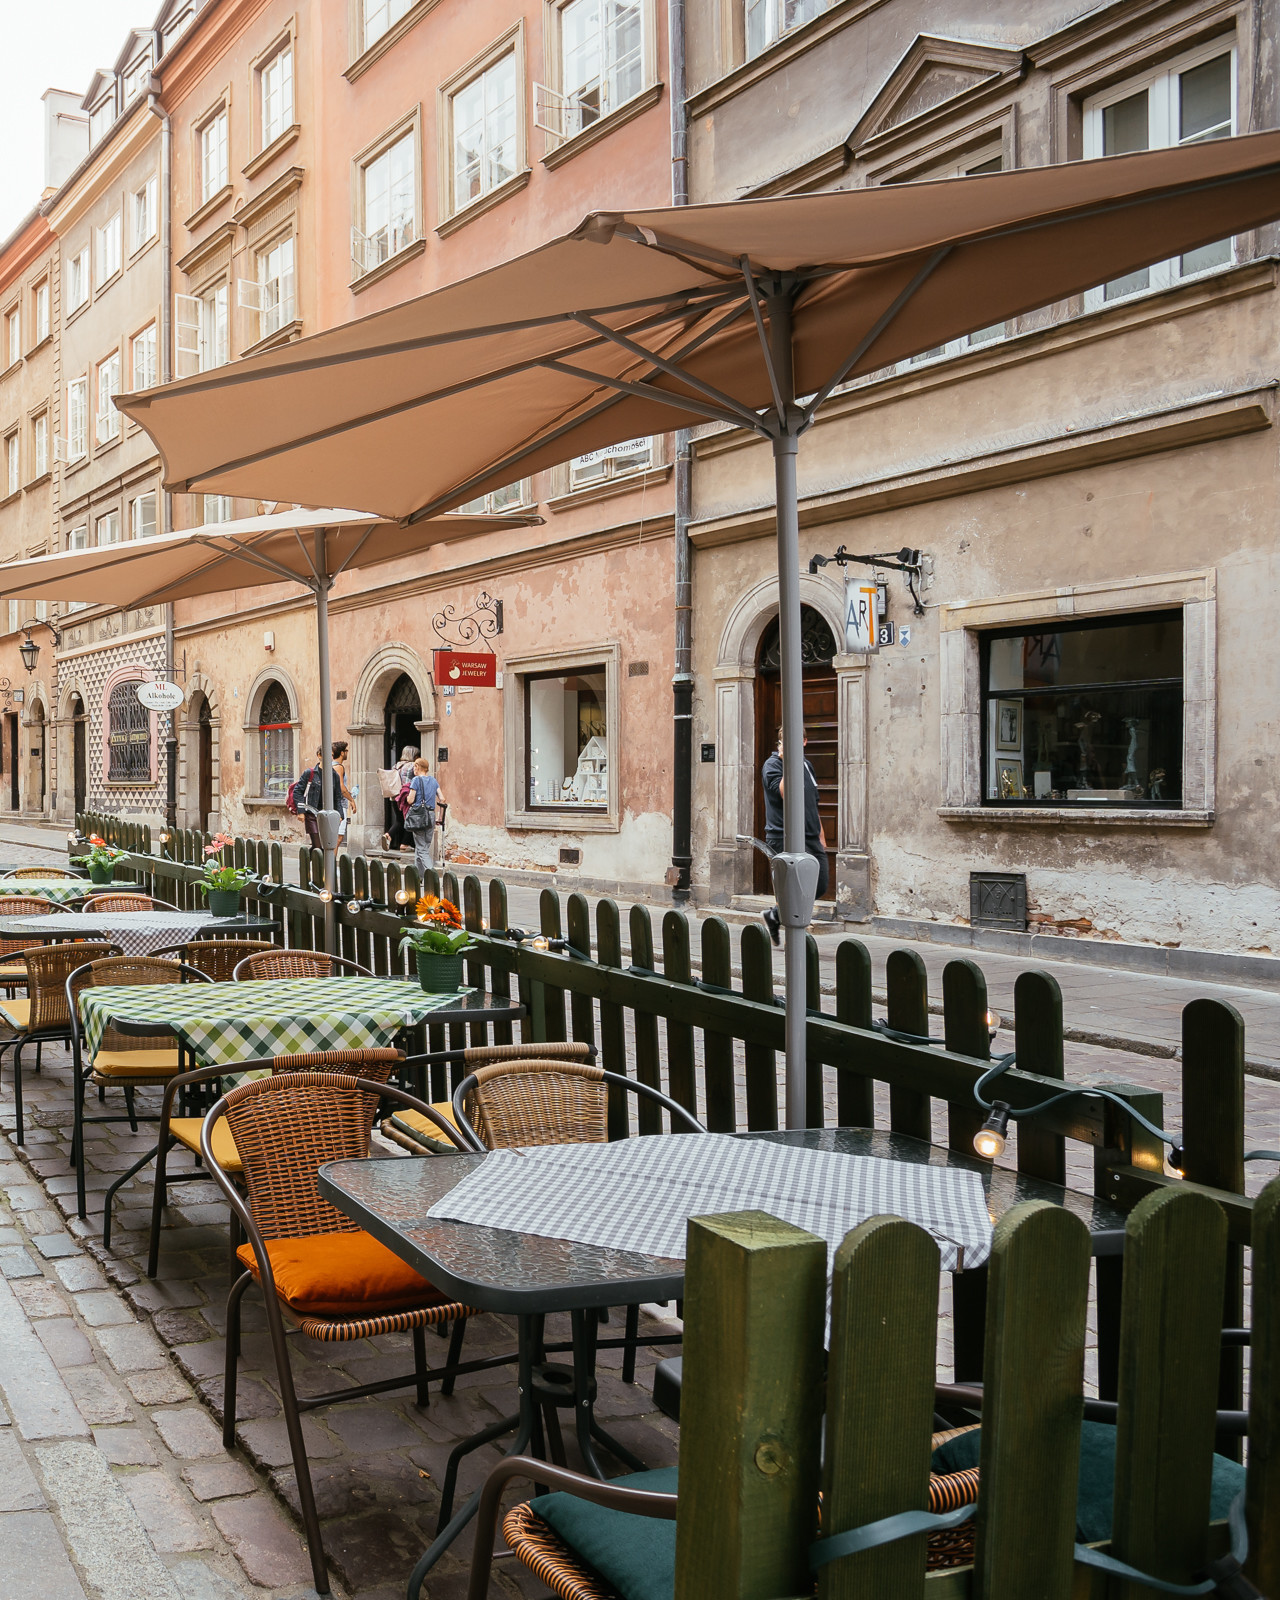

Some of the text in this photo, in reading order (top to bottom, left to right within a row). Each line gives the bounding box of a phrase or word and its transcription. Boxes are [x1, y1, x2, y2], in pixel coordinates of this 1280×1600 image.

[580, 453, 594, 464] ABC
[846, 587, 877, 646] ART
[154, 683, 167, 691] ML
